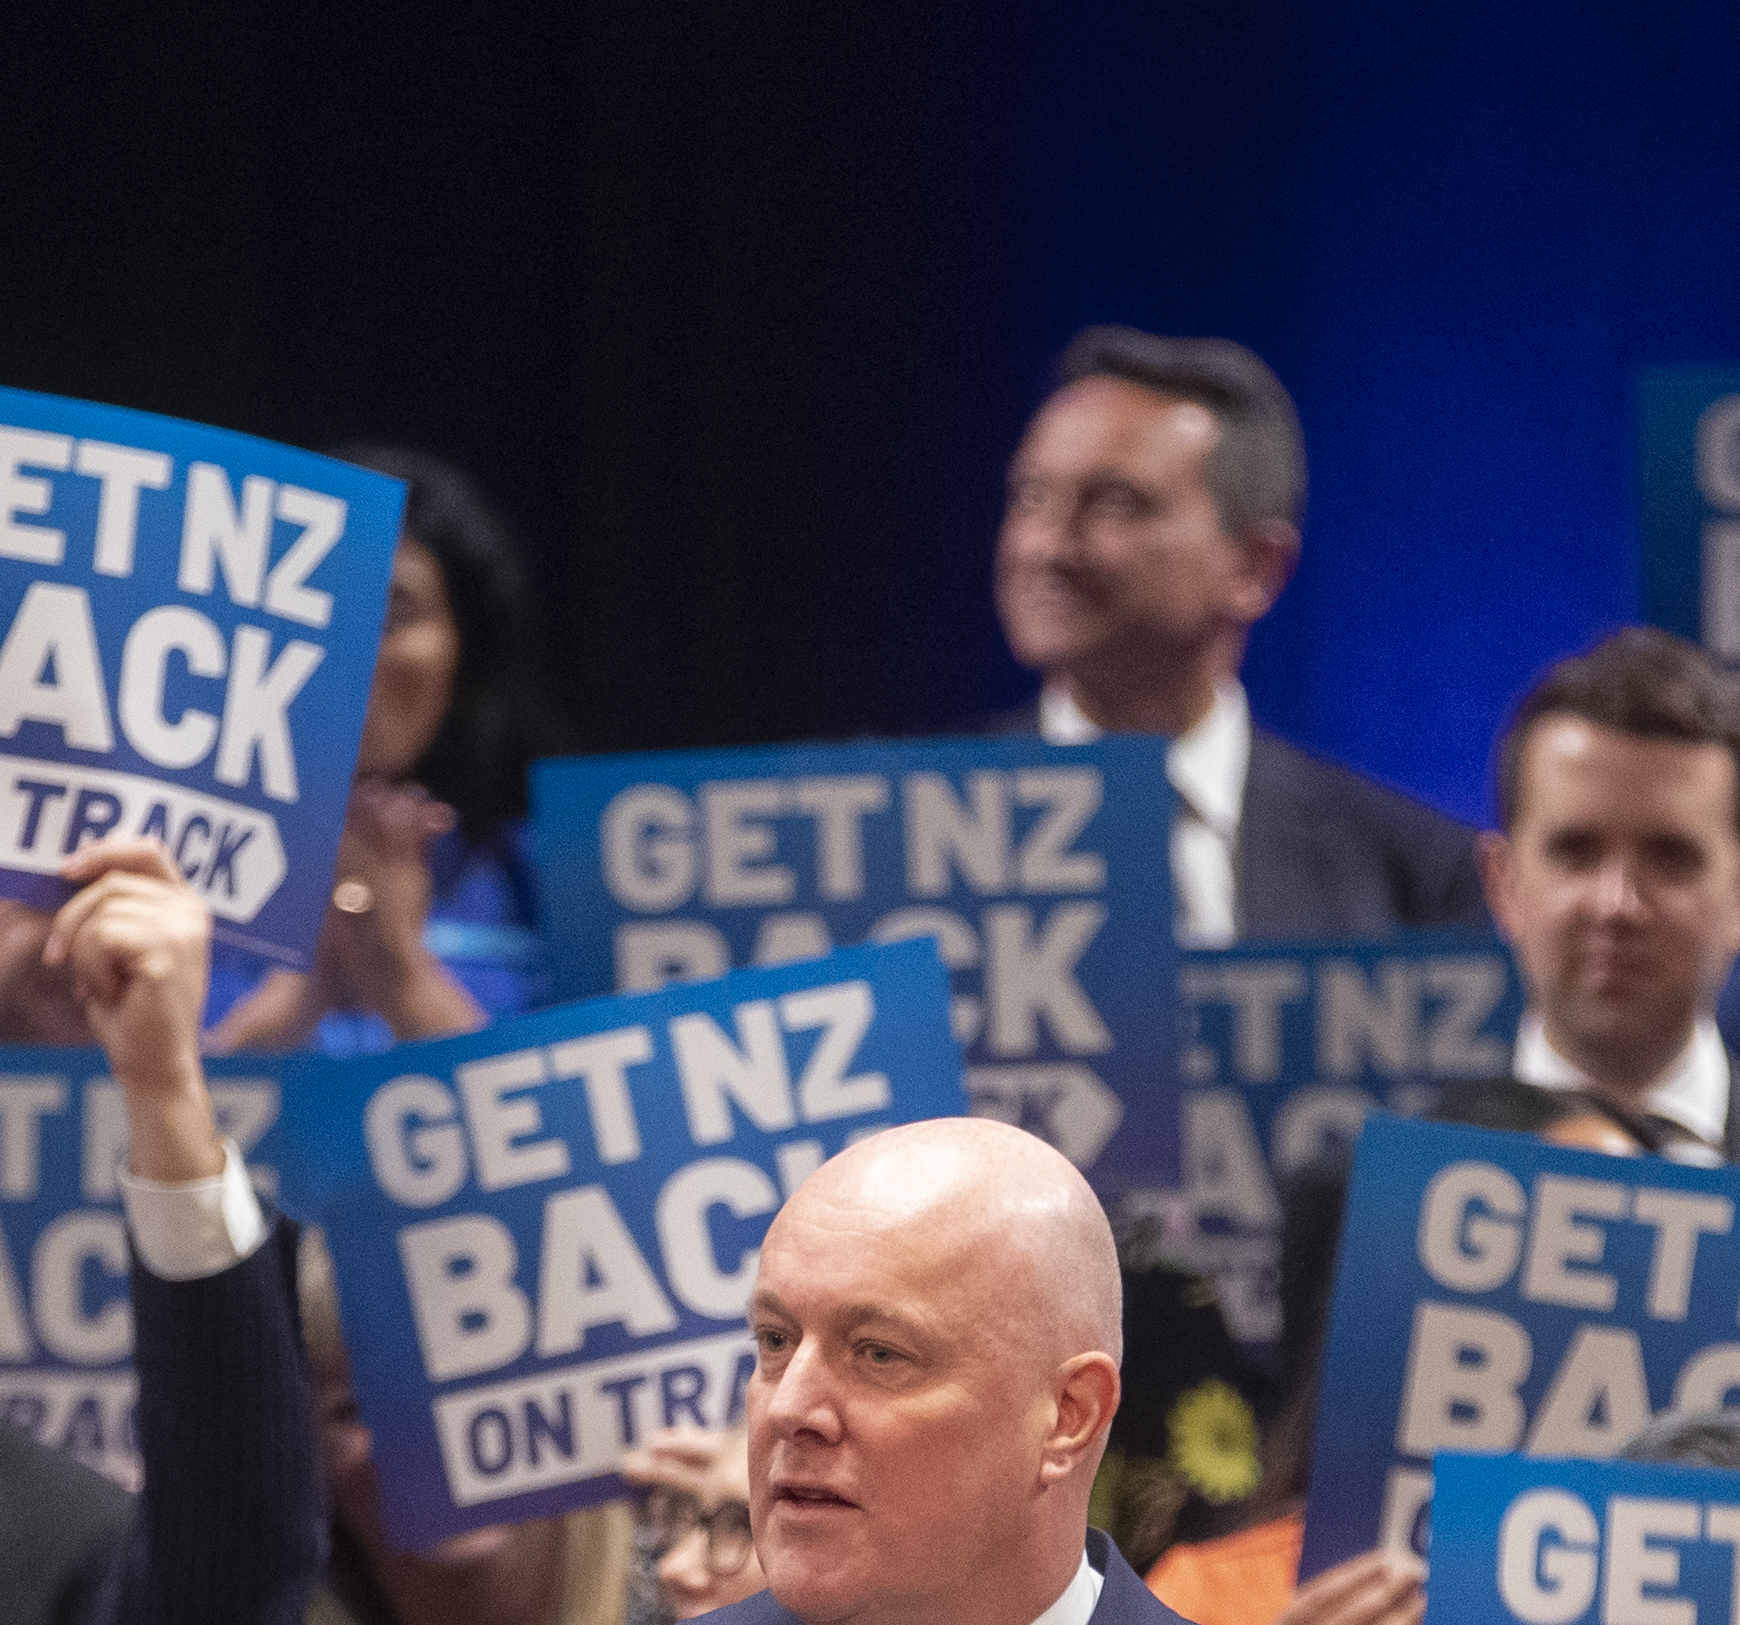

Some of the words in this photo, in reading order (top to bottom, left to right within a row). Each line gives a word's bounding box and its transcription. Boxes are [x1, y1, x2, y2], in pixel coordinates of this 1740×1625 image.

[178, 461, 348, 630] NZ
[599, 776, 892, 913] GET
[904, 764, 1108, 898] NZ
[364, 1027, 653, 1208] GET
[668, 981, 892, 1146] NZ
[398, 1125, 892, 1383] BAC
[1417, 1160, 1734, 1321] GET
[468, 1391, 577, 1475] ON
